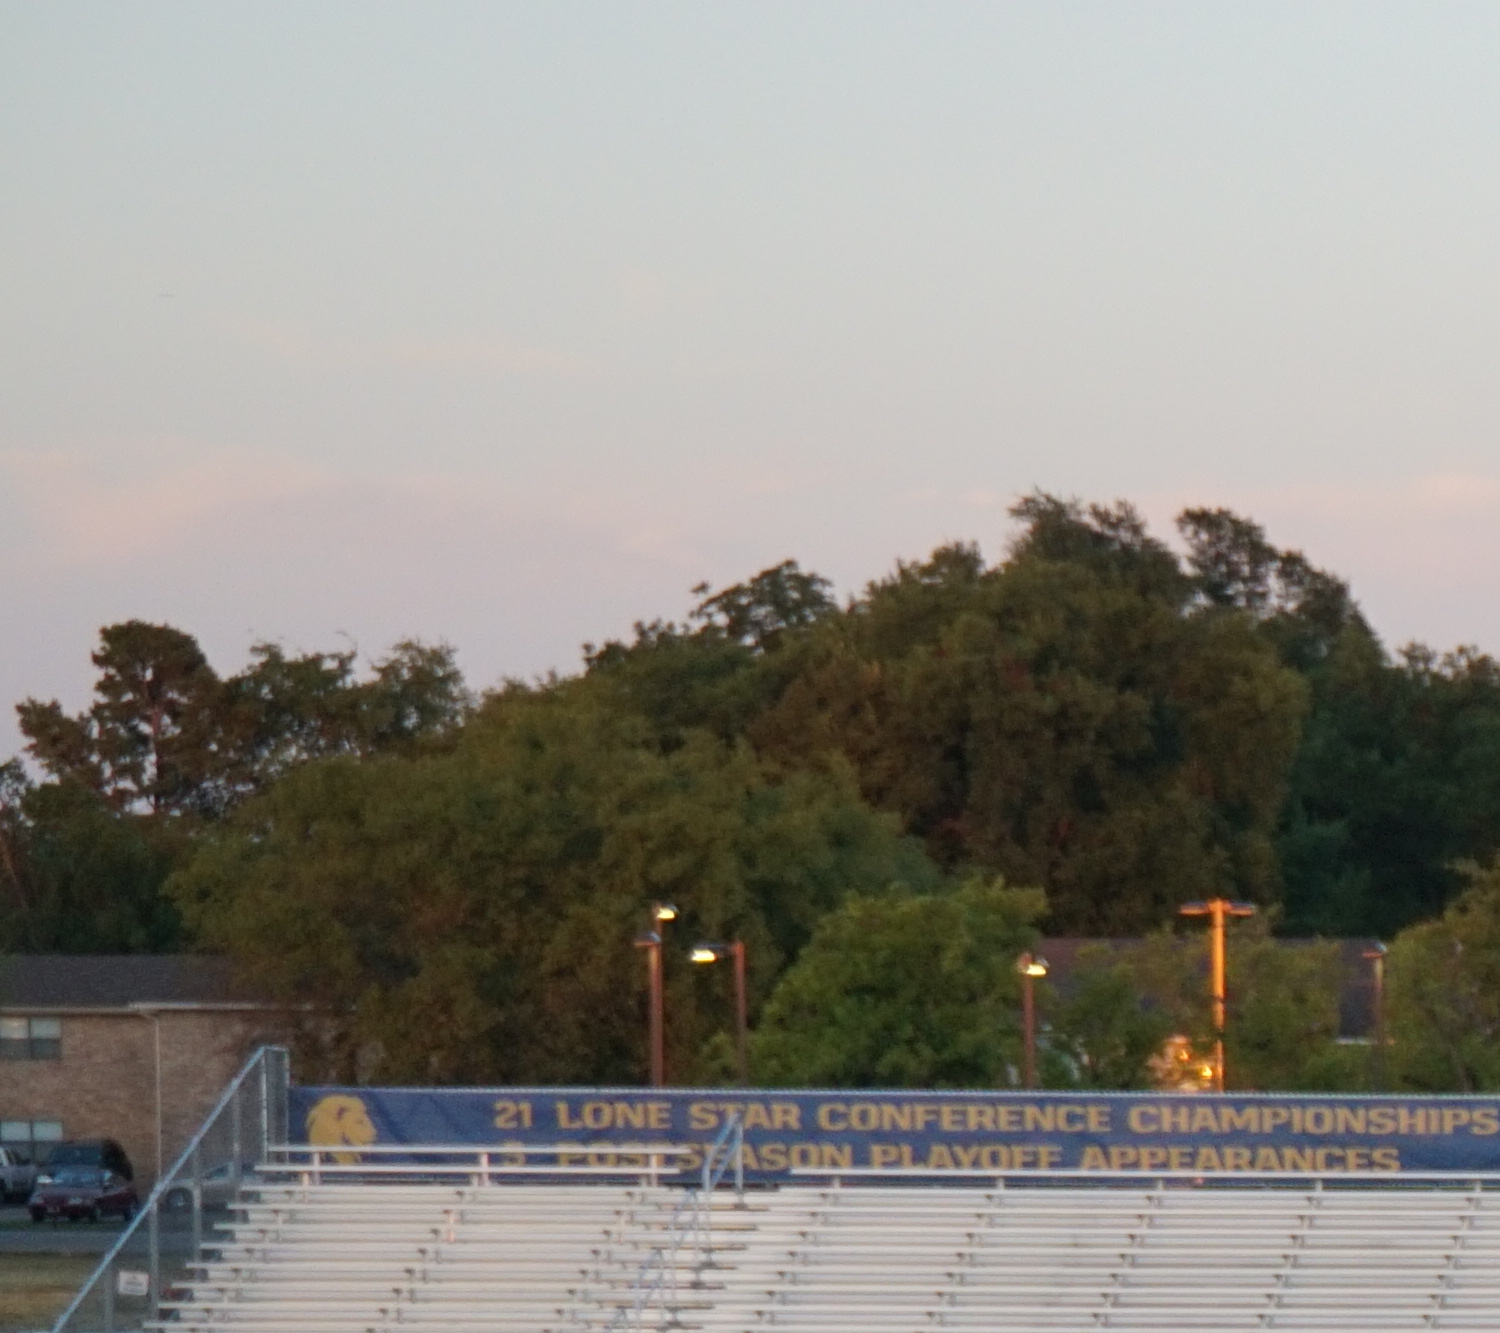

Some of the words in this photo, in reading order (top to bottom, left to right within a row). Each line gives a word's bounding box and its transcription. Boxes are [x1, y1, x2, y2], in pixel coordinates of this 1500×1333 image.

[494, 1101, 533, 1130] 21
[557, 1101, 672, 1131] LONE
[689, 1101, 800, 1131] STAR
[818, 1102, 1111, 1133] CONFERENCE
[1127, 1103, 1500, 1137] CHAMPIONSHIPS
[869, 1144, 1063, 1172] PLAYOFF
[1080, 1145, 1400, 1173] APPEARANCES
